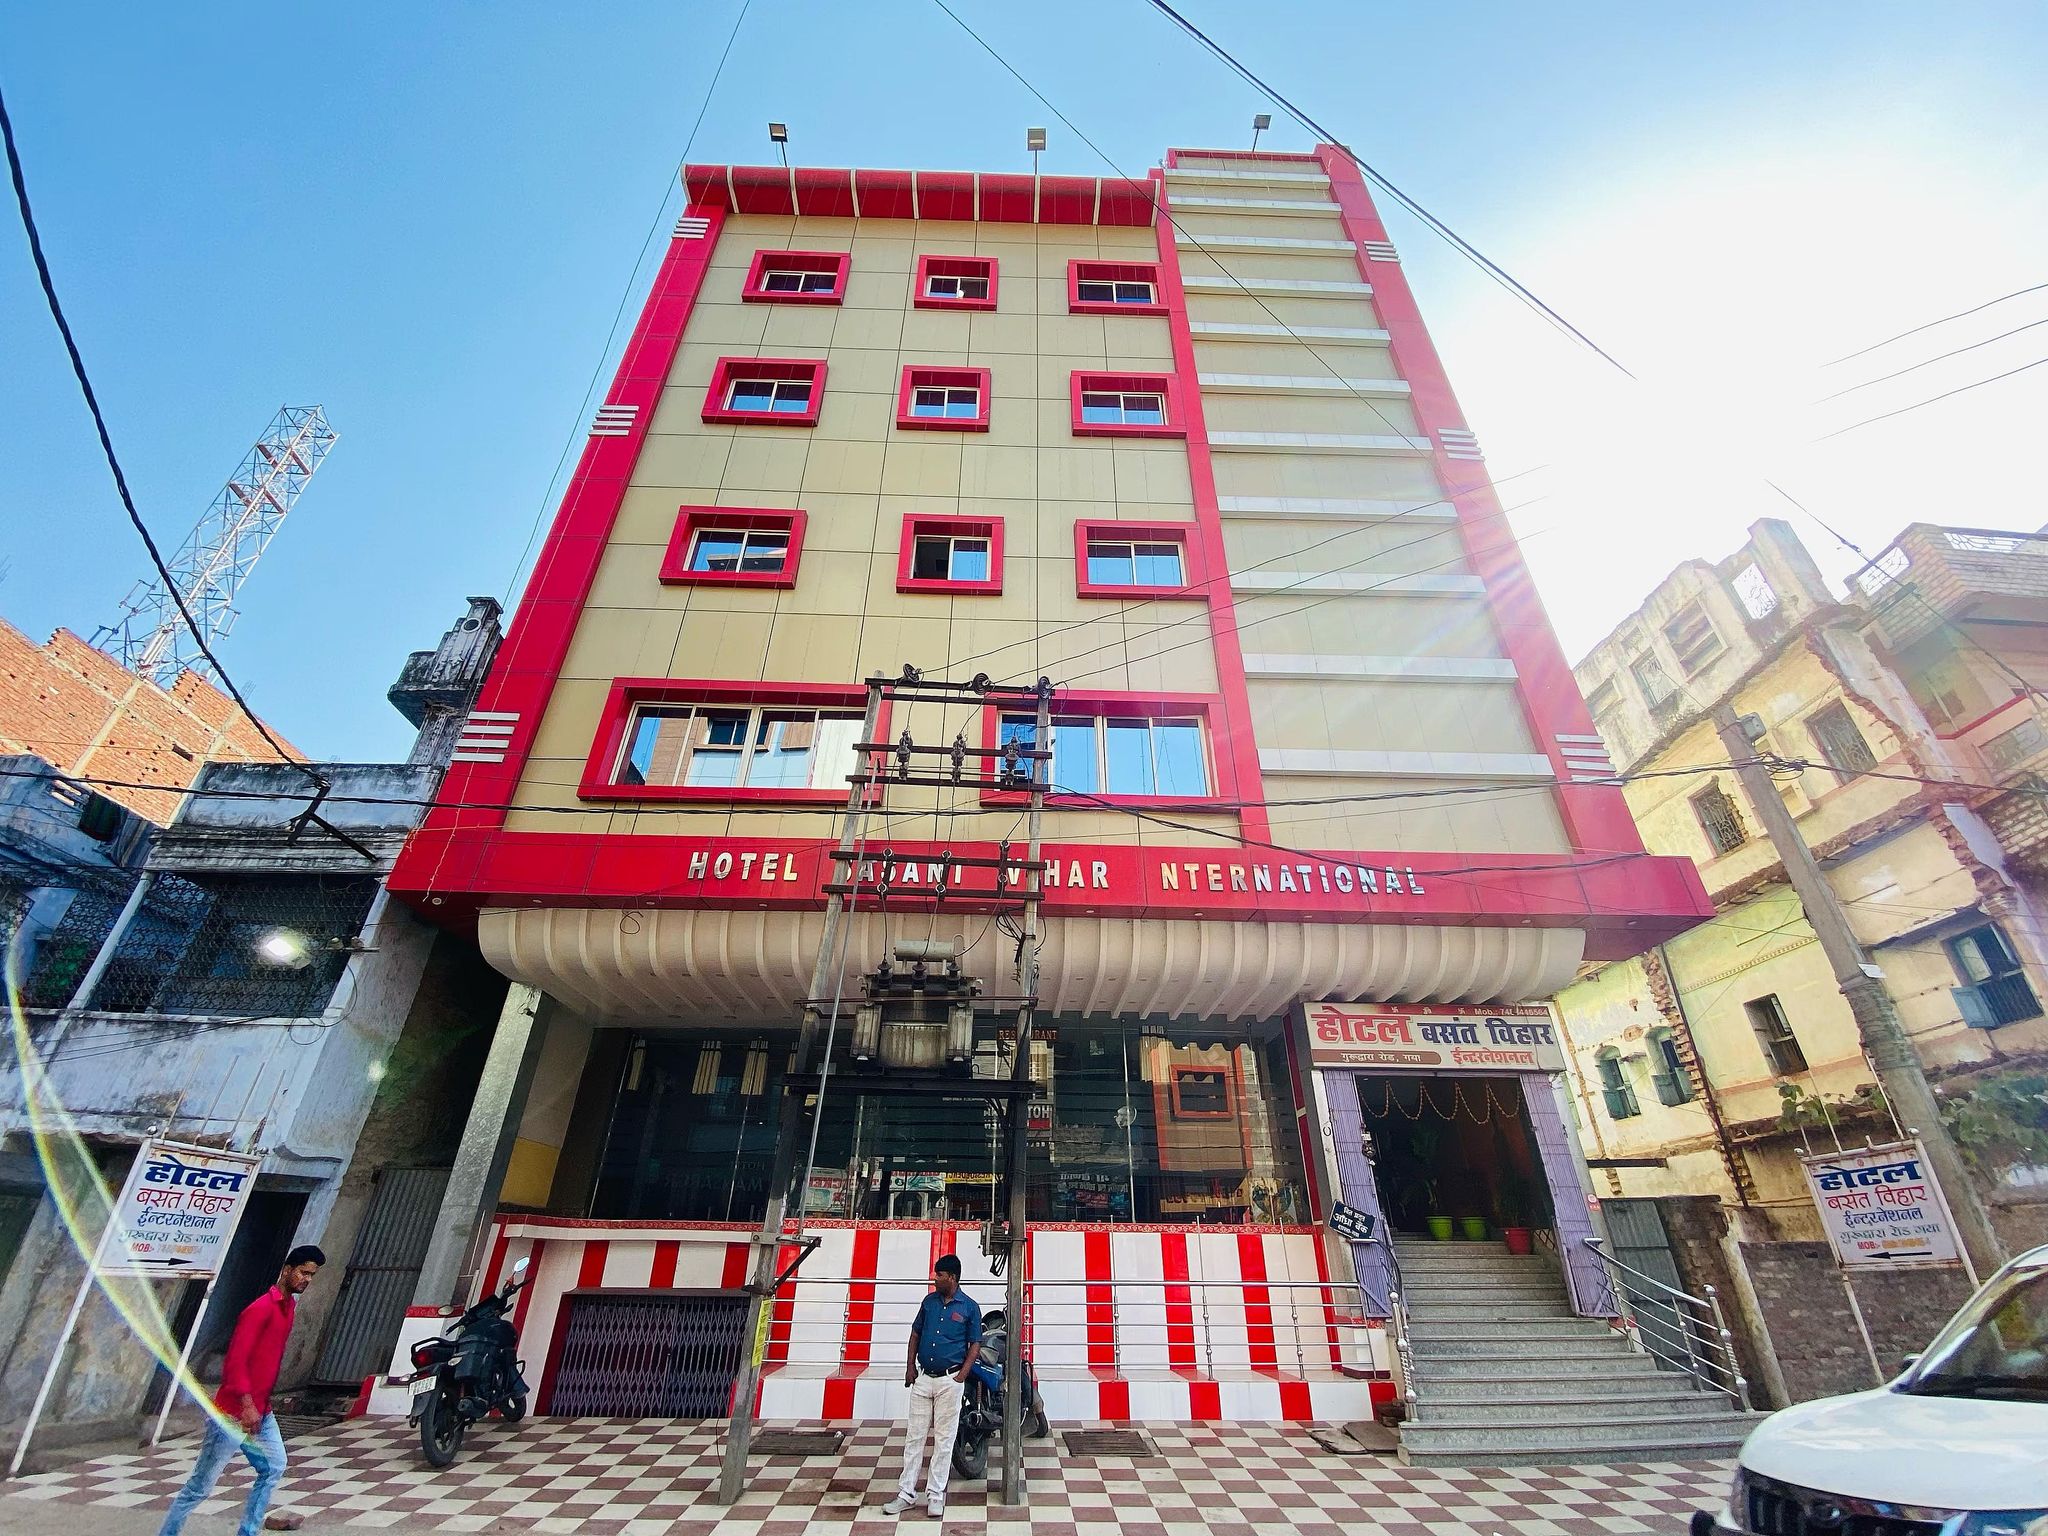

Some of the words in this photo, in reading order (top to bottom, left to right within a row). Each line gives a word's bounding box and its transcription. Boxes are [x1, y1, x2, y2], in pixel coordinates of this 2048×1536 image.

[688, 851, 798, 882] HOTEL
[844, 858, 963, 885] ASAN
[1006, 857, 1110, 888] VHAR
[998, 1029, 1058, 1040] RESRANT
[1310, 1005, 1415, 1043] होटल
[1416, 1017, 1480, 1045] बसंत
[1485, 1017, 1555, 1045] विहार
[1403, 1054, 1421, 1062] गया
[145, 1153, 248, 1192] होटल
[1812, 1160, 1923, 1191] होटल
[136, 1185, 184, 1208] बसंत
[187, 1188, 236, 1215] विहार
[1825, 1189, 1872, 1211] बसंत
[1875, 1184, 1928, 1207] विहार
